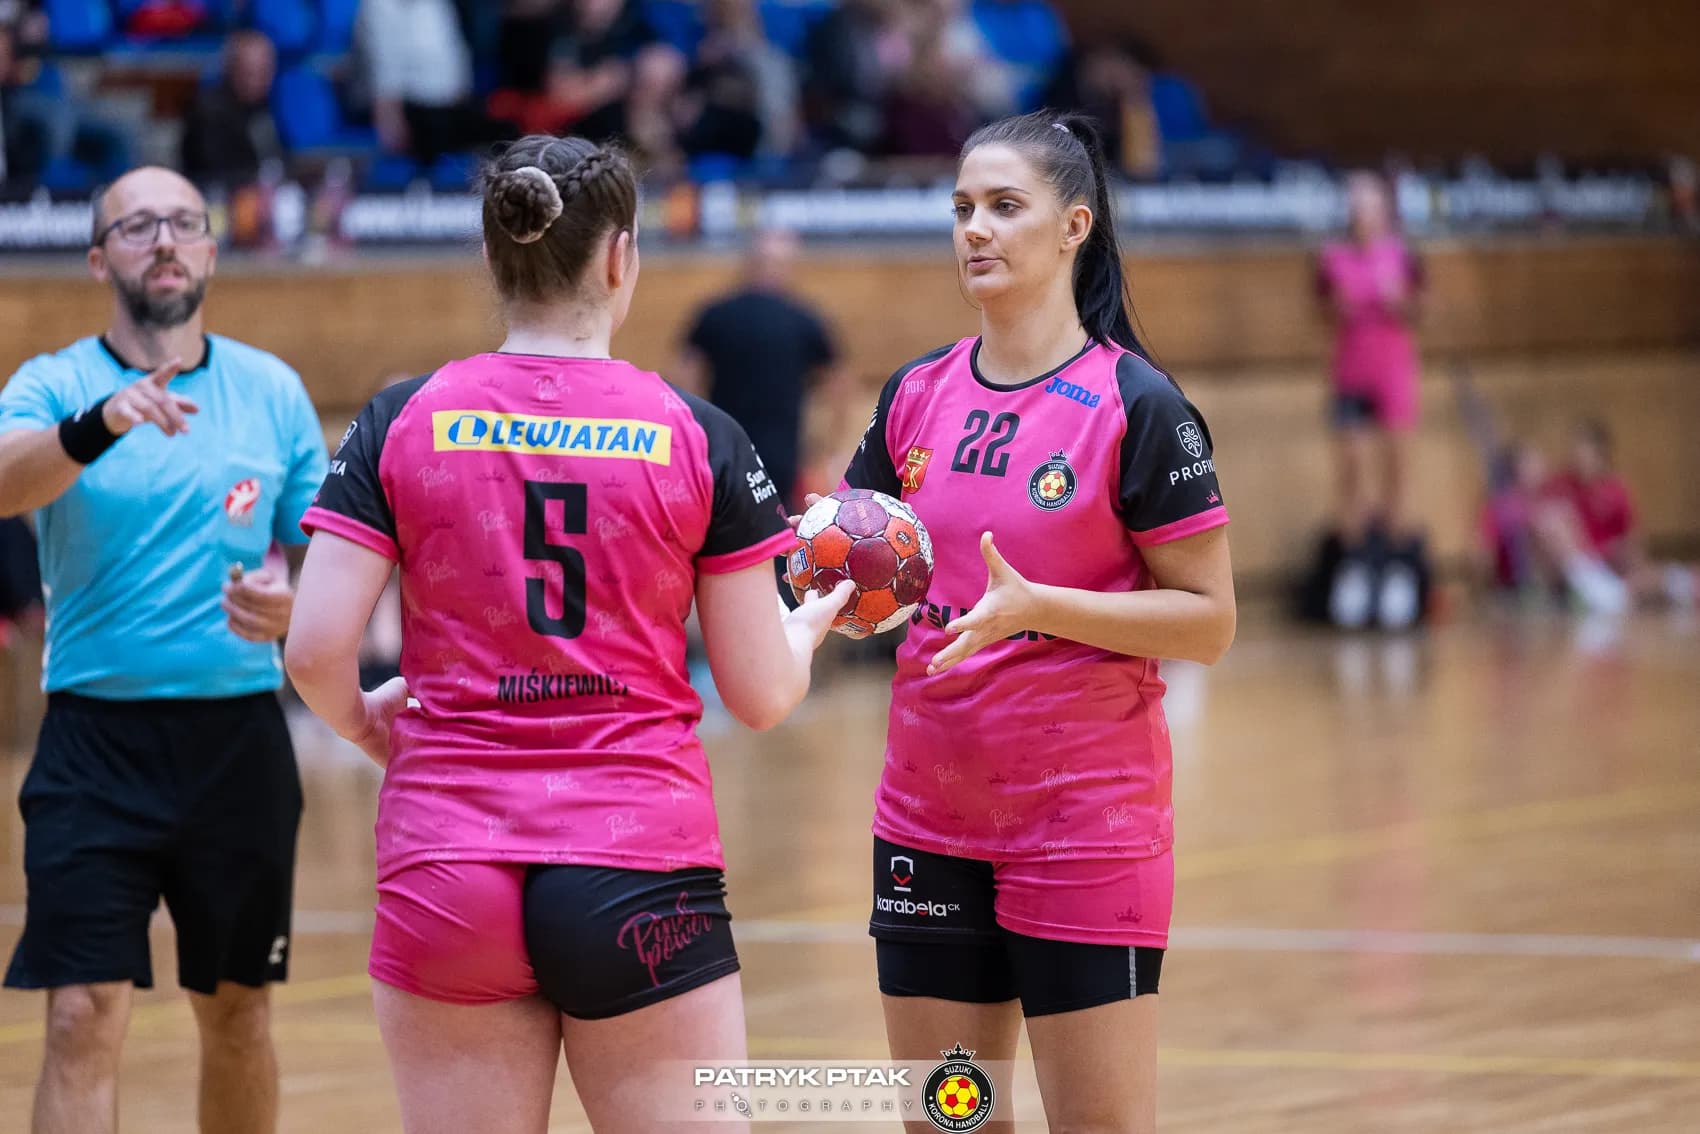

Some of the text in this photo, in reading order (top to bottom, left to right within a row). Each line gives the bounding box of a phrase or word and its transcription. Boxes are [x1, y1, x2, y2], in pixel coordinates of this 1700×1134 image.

[491, 419, 657, 454] LEWIATAN
[951, 409, 1020, 477] 22
[523, 480, 587, 638] 5
[876, 893, 947, 917] karabela
